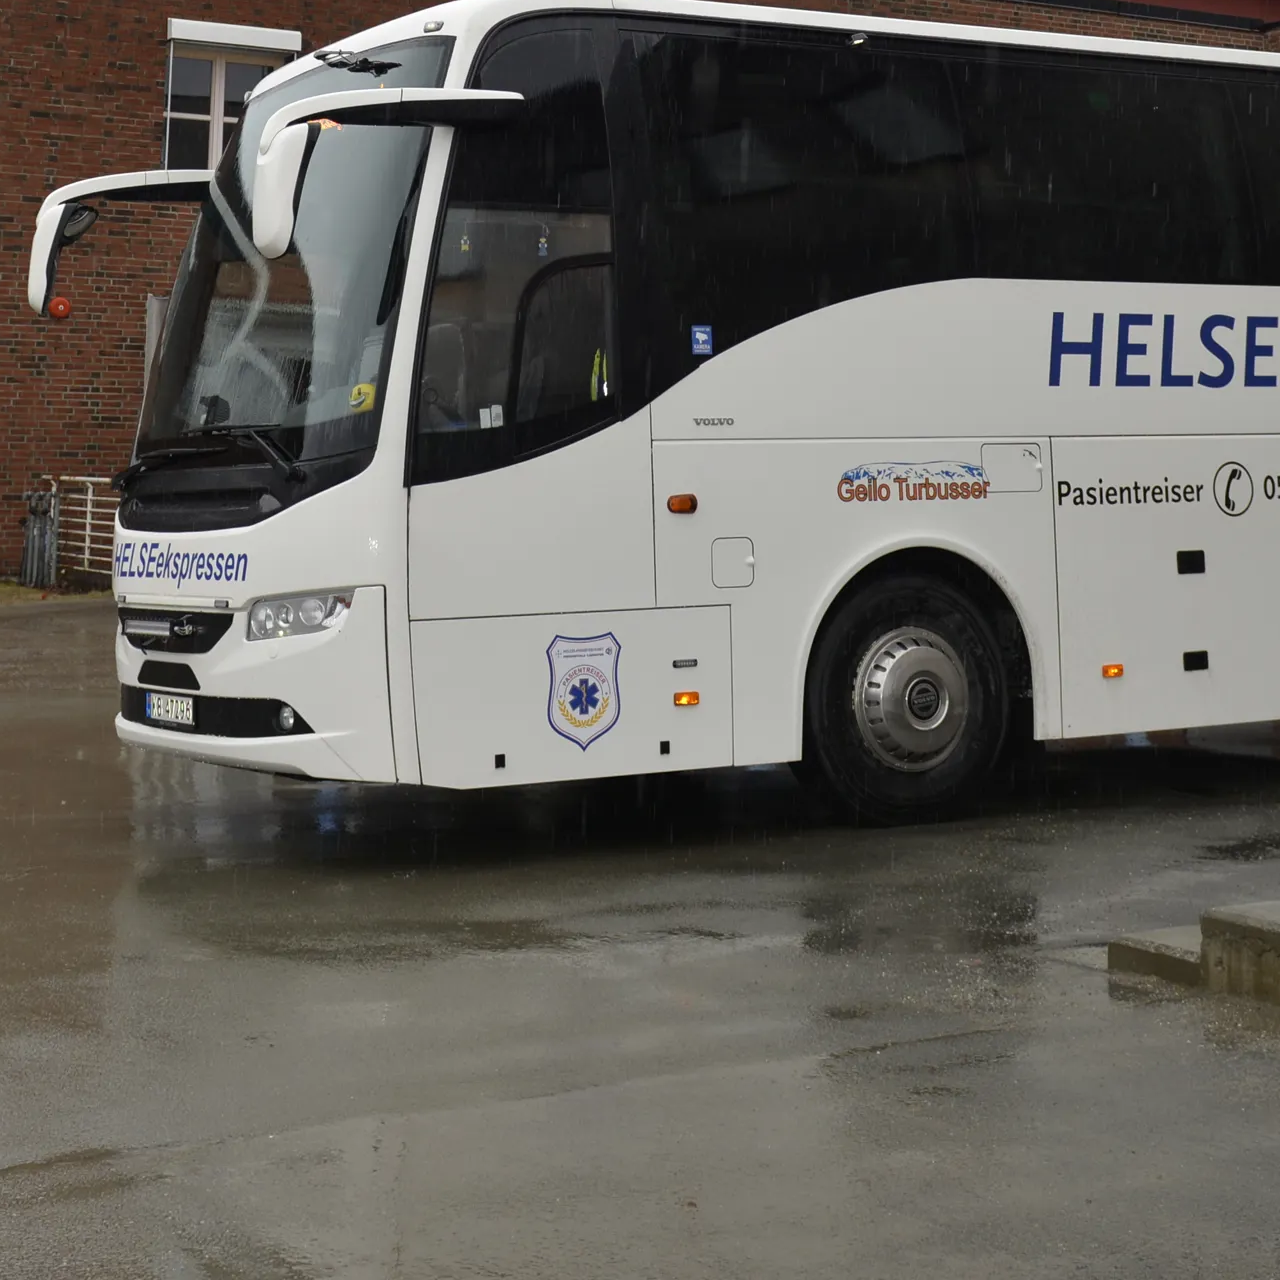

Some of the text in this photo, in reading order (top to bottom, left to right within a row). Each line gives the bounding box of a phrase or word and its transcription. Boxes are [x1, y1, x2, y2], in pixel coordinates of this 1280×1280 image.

[692, 417, 735, 426] VOLVO
[837, 476, 991, 502] Geilo Turbusser
[1057, 476, 1204, 506] Pasientreiser
[114, 542, 248, 589] HELSEekspressen
[563, 667, 606, 686] PASIENTREISER
